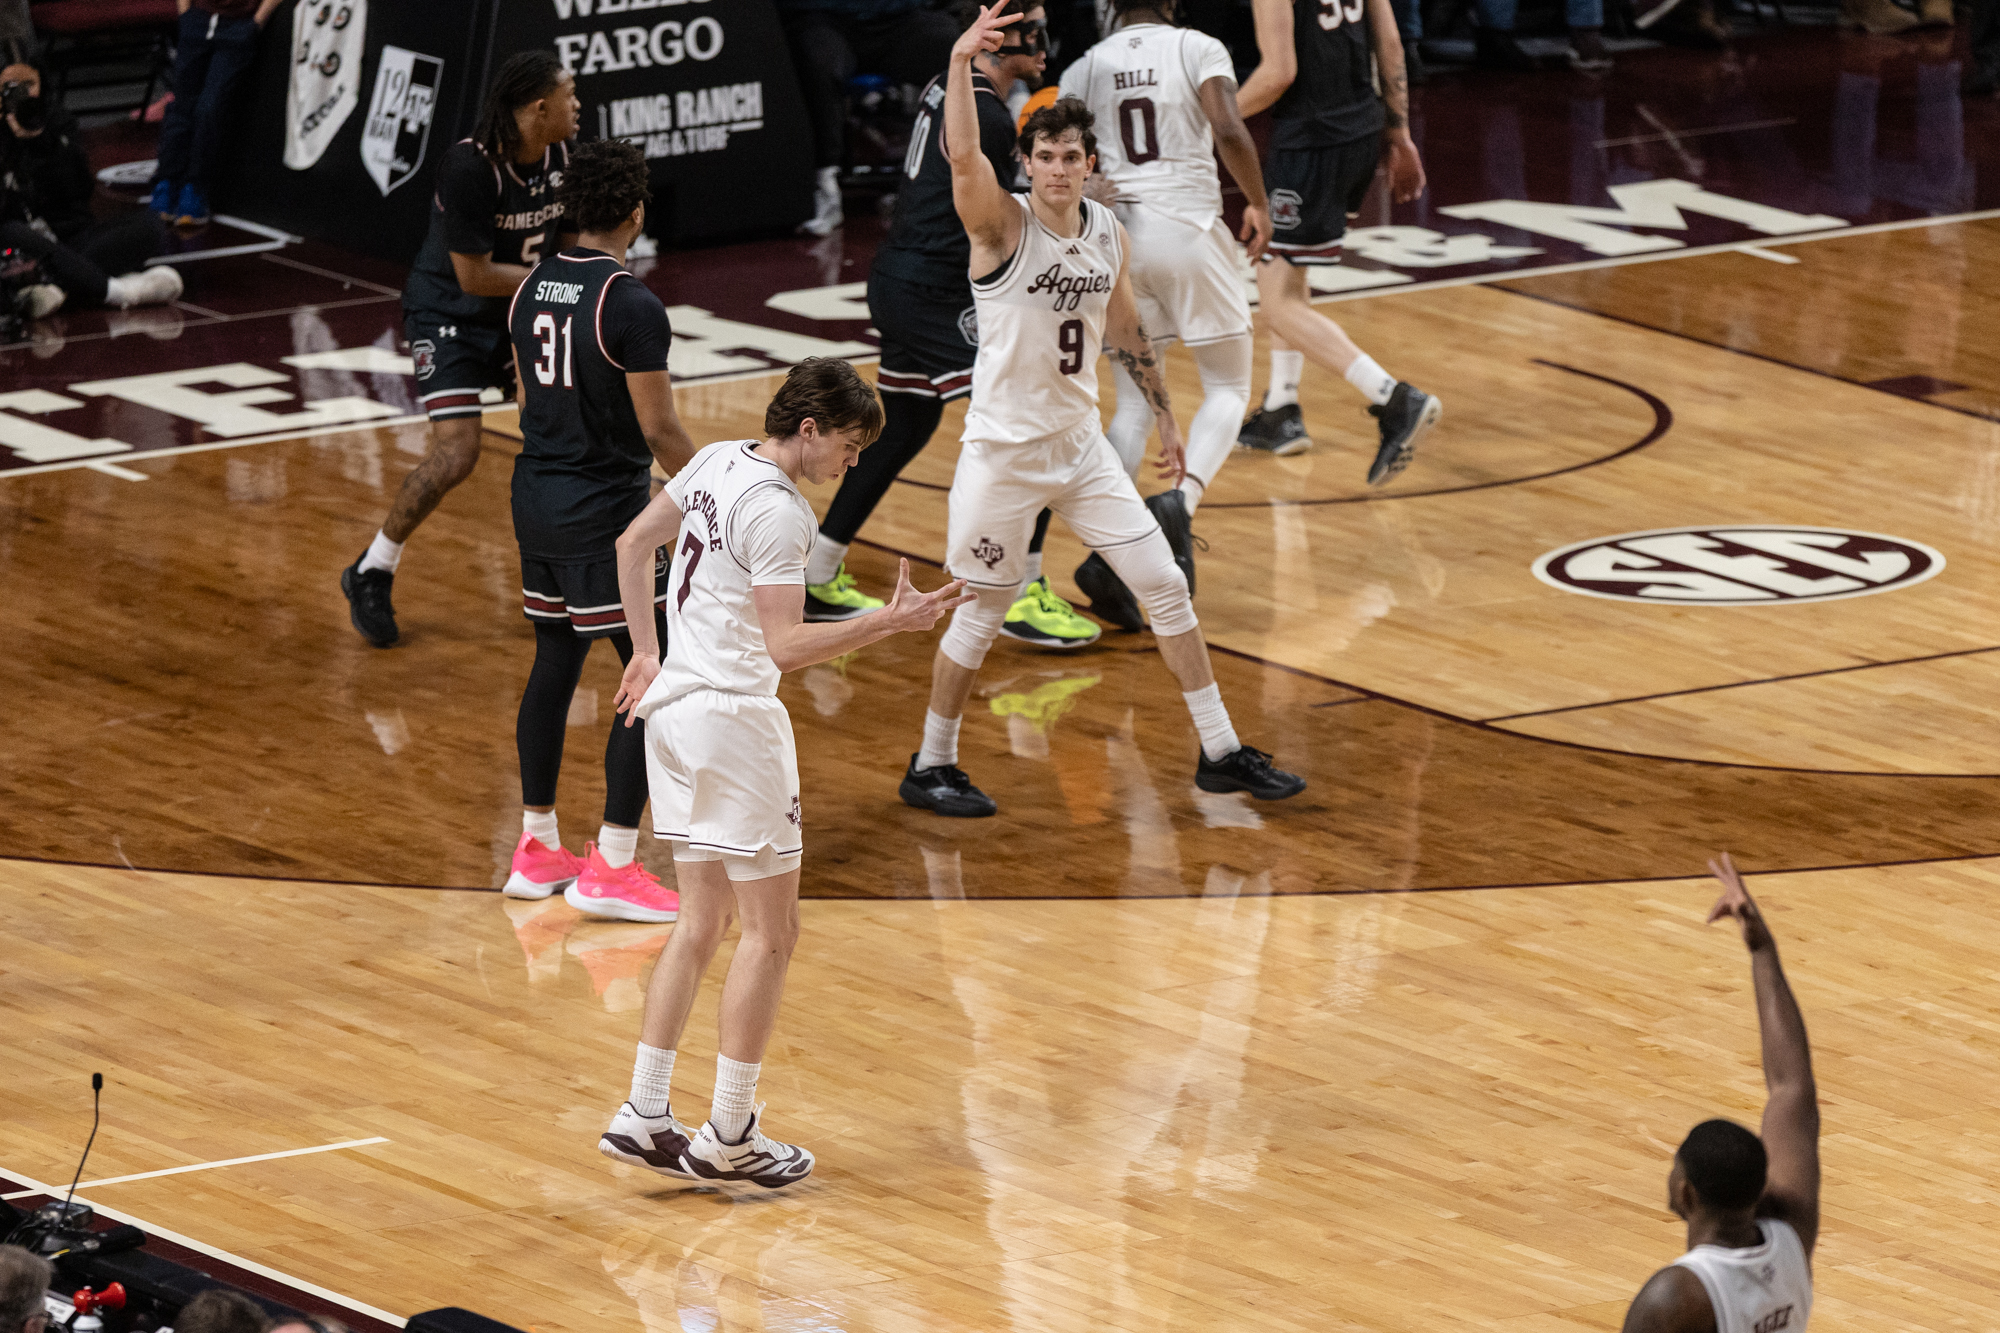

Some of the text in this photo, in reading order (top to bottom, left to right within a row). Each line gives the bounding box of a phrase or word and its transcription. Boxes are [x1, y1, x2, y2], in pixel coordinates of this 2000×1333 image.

[554, 16, 724, 76] FARGO
[1113, 68, 1158, 90] HILL
[610, 81, 764, 138] KING RANCH
[1119, 97, 1159, 166] 0
[521, 232, 546, 268] 5
[534, 280, 584, 305] STRONG
[1027, 263, 1112, 312] Aggies
[533, 311, 574, 389] 31
[1058, 319, 1084, 376] 9
[676, 529, 705, 616] 7
[1564, 529, 1912, 600] SEC
